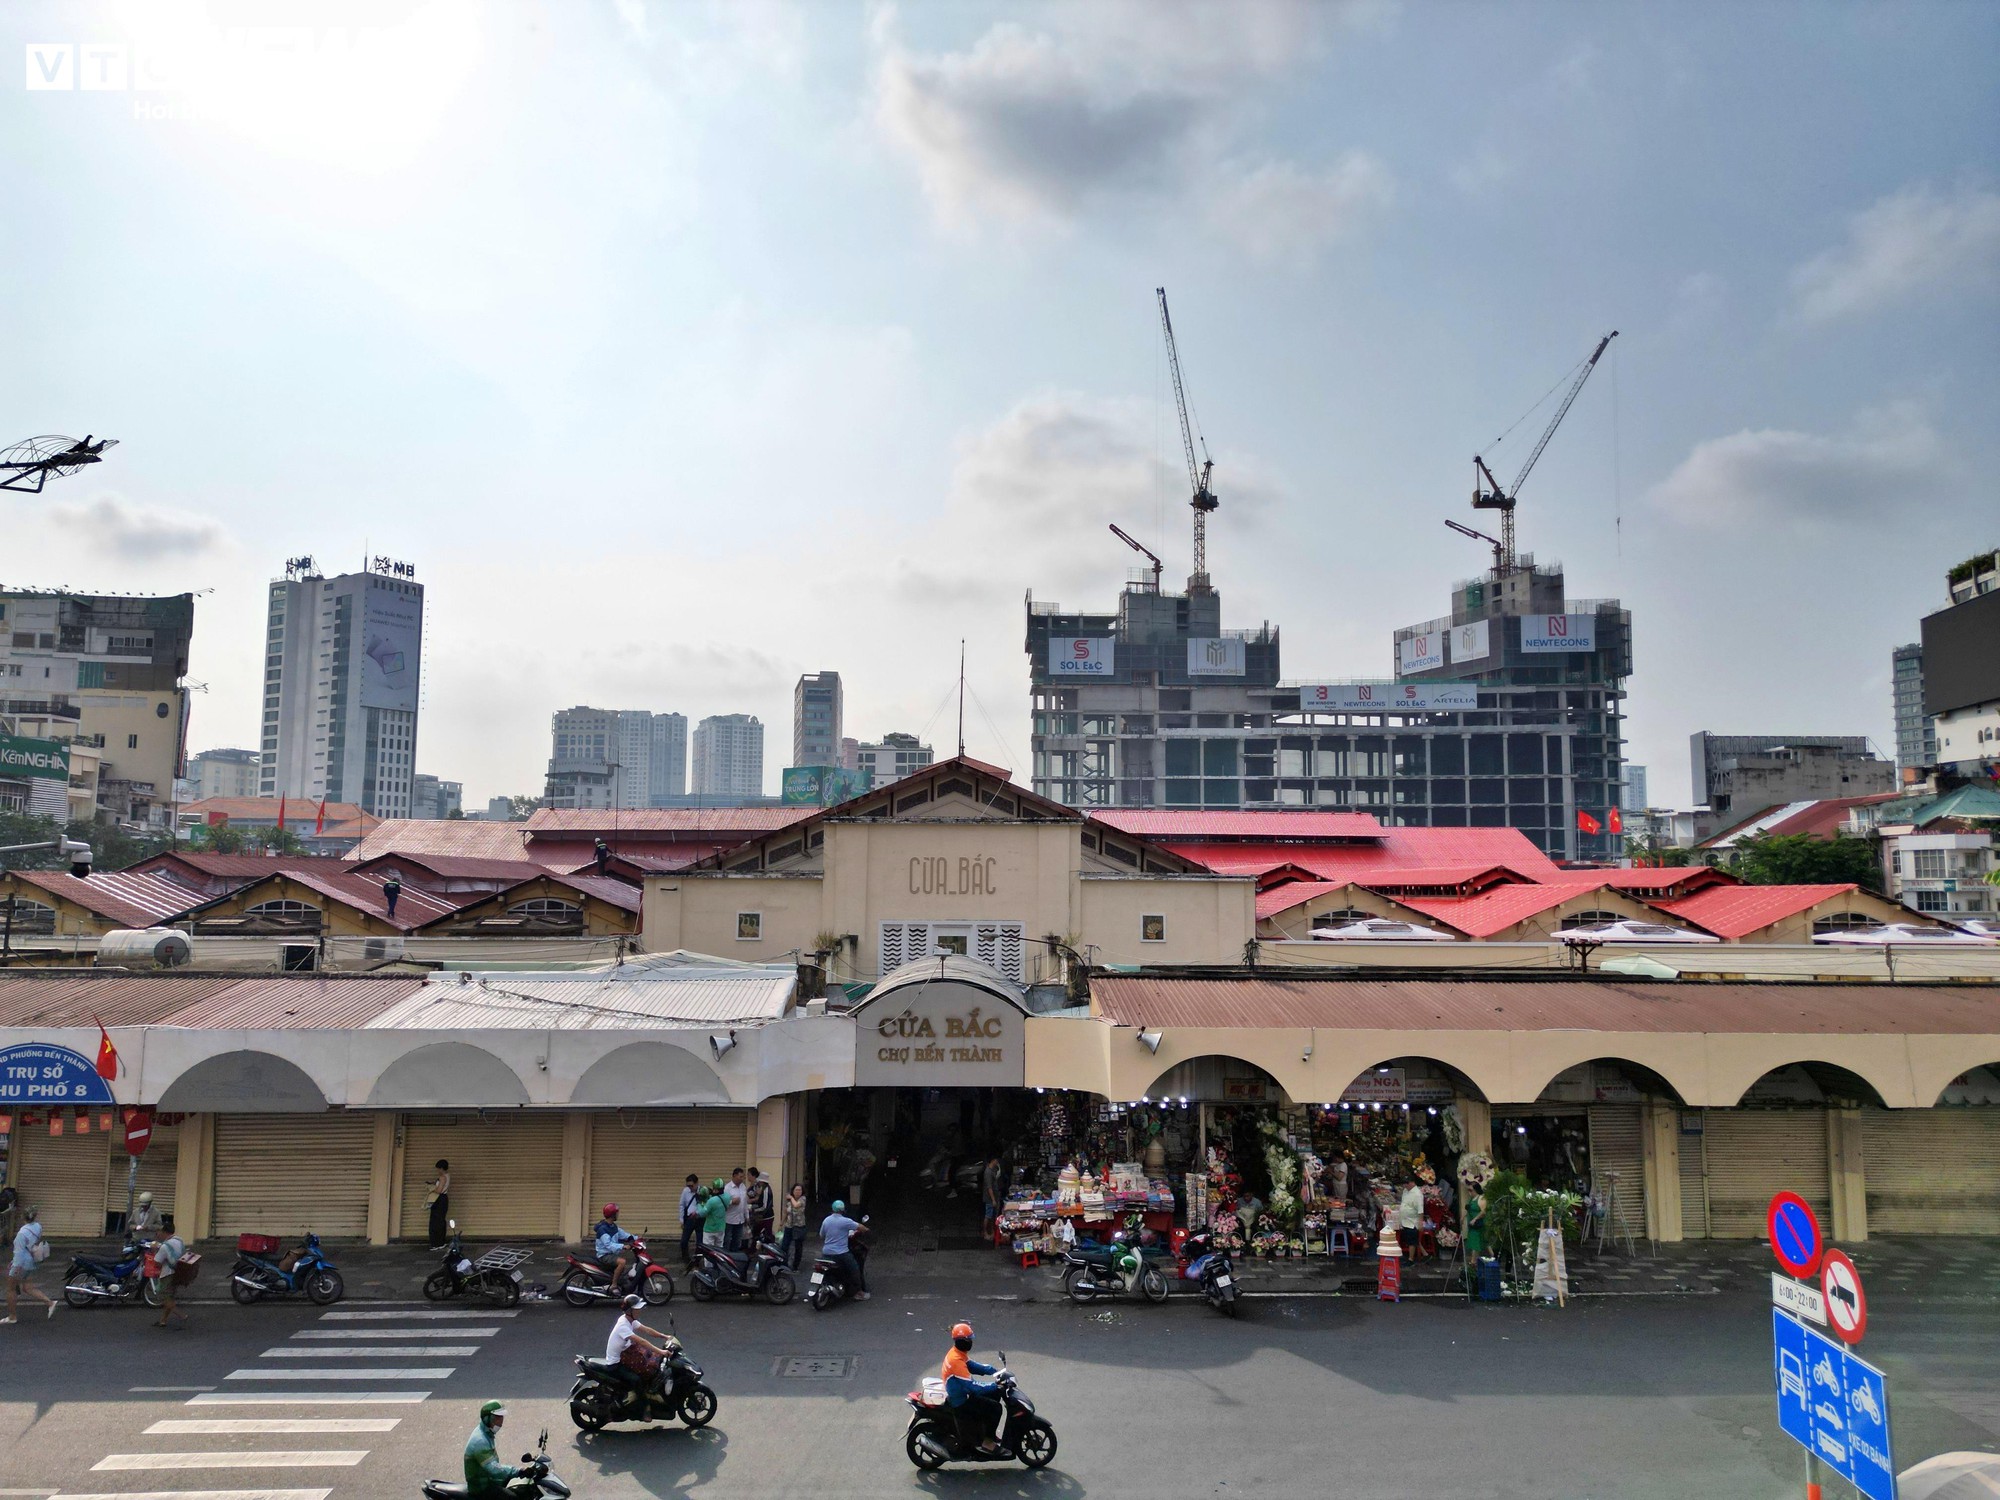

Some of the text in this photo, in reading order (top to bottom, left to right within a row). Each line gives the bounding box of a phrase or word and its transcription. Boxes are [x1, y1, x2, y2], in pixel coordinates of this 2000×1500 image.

[394, 562, 415, 577] MB
[1525, 638, 1589, 647] NEWTECONS
[1060, 661, 1103, 670] SOL E&C
[1403, 655, 1440, 670] NEWTECONS
[878, 1007, 1002, 1038] CỬA BẮC
[44, 1050, 60, 1059] BẾN
[62, 1055, 88, 1072] THÀNH
[878, 1042, 1002, 1064] CHỢ BẾN THÀNH
[7, 1062, 64, 1080] TRỤ SỞ
[27, 1080, 70, 1097] PHỐ
[74, 1084, 87, 1097] 8
[1373, 1077, 1401, 1087] NGA
[1852, 1434, 1890, 1474] XE 02 BÁNH
